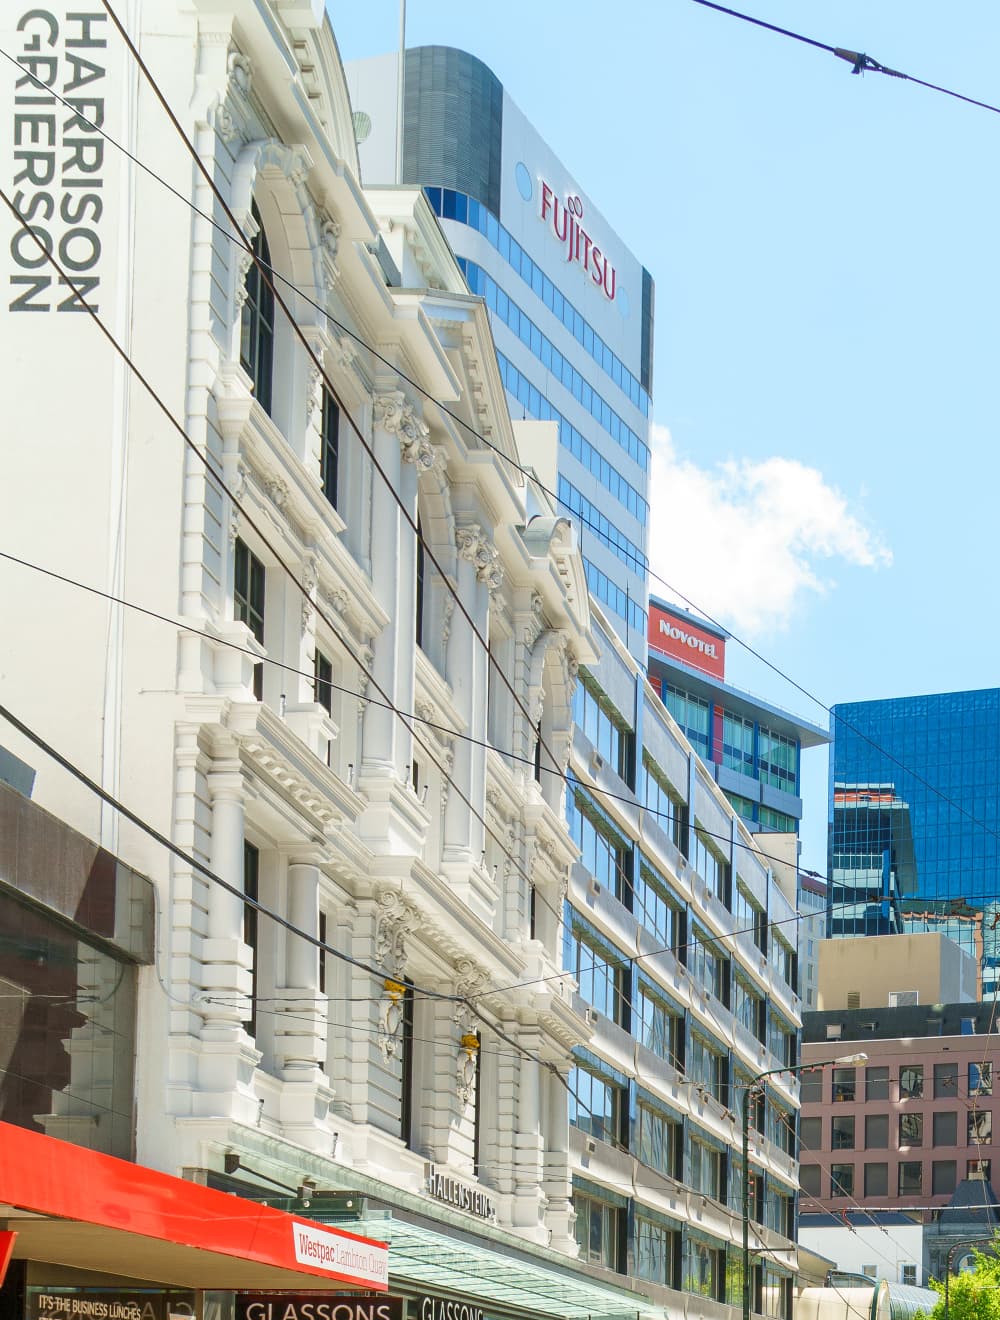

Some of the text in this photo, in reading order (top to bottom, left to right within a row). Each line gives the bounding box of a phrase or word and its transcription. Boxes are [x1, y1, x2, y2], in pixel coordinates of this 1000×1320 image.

[9, 9, 59, 312] GRIERSON
[57, 12, 107, 312] HARRISON
[541, 180, 615, 300] FUJITSU
[659, 619, 719, 659] NOVOTEL
[299, 1233, 386, 1279] Westpac Lambton Quay
[39, 1294, 141, 1320] IT'S THE BUSINESS LUNCHES
